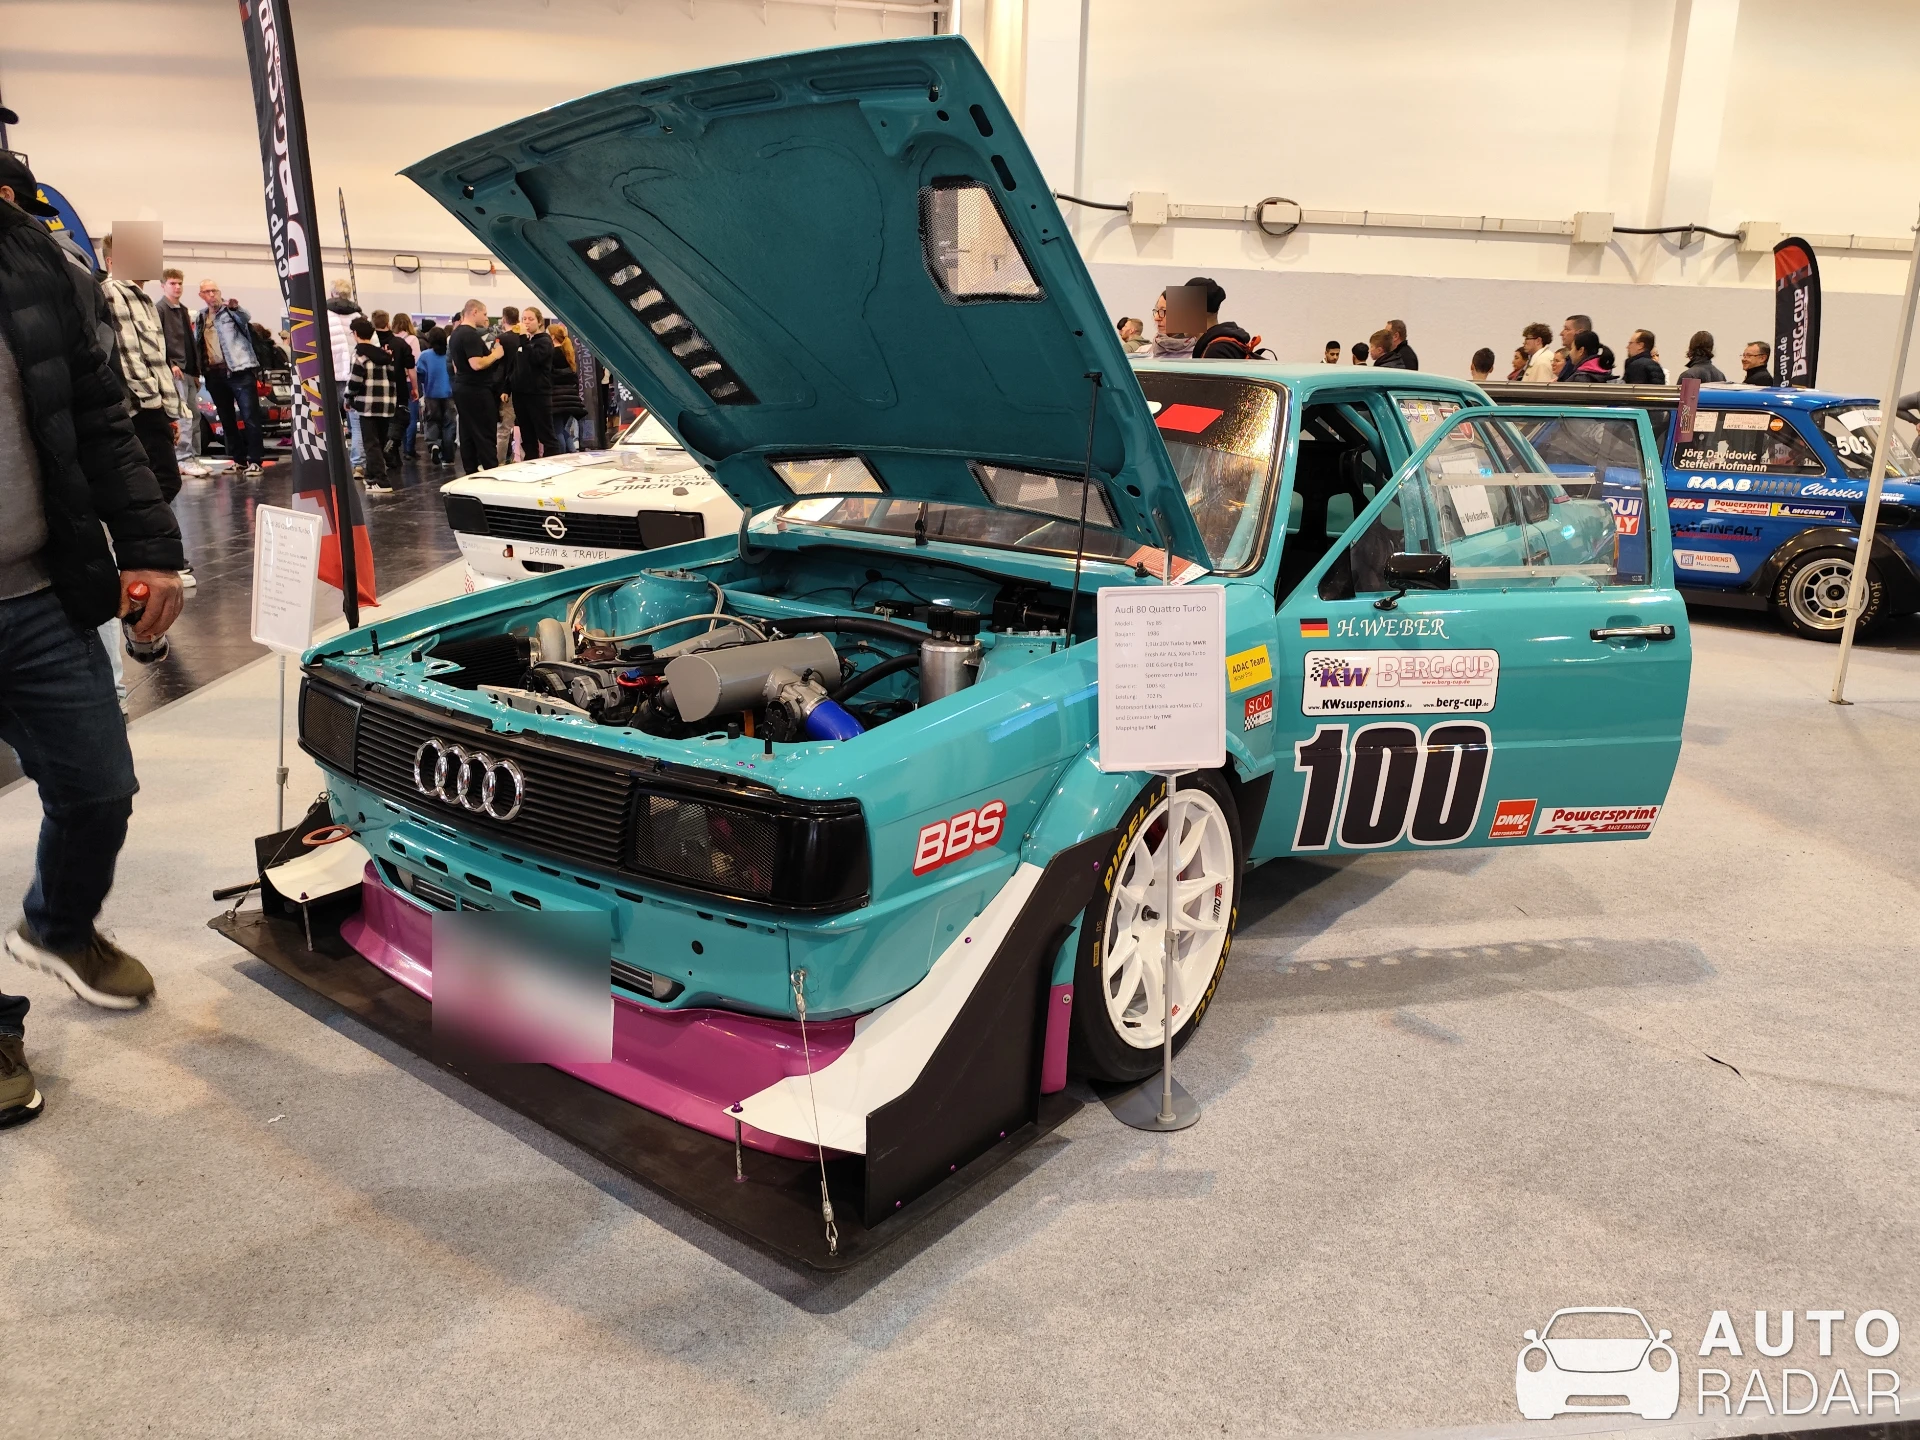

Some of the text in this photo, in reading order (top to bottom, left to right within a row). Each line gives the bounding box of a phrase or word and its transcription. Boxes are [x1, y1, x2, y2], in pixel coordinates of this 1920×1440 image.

[1790, 285, 1808, 379] BERG-CUP
[1682, 447, 1703, 460] Jörg
[1705, 449, 1758, 461] Davidovic
[1835, 436, 1873, 456] 503
[1679, 459, 1716, 470] Steffen
[1717, 460, 1768, 472] Hofmann
[1687, 475, 1752, 492] RAAB
[1800, 482, 1864, 499] Classics
[1714, 500, 1769, 510] Powersprint
[1791, 508, 1837, 516] MICHELIN
[1699, 523, 1763, 537] EINFALT
[529, 546, 610, 559] DREAM & TRAVEL
[1695, 554, 1733, 563] AUTODIENST
[1114, 604, 1207, 614] Audi 80 Quattro Turbo
[1336, 615, 1450, 640] H.WEBER
[1232, 656, 1266, 675] ADAC Team
[1319, 656, 1495, 688] KW BERG-CUP
[1248, 694, 1270, 715] SCC
[1290, 719, 1494, 852] 100
[1495, 813, 1530, 826] DMV
[1552, 806, 1657, 823] Powersprint
[912, 799, 1006, 875] BBS
[1103, 781, 1167, 894] PIRELLI
